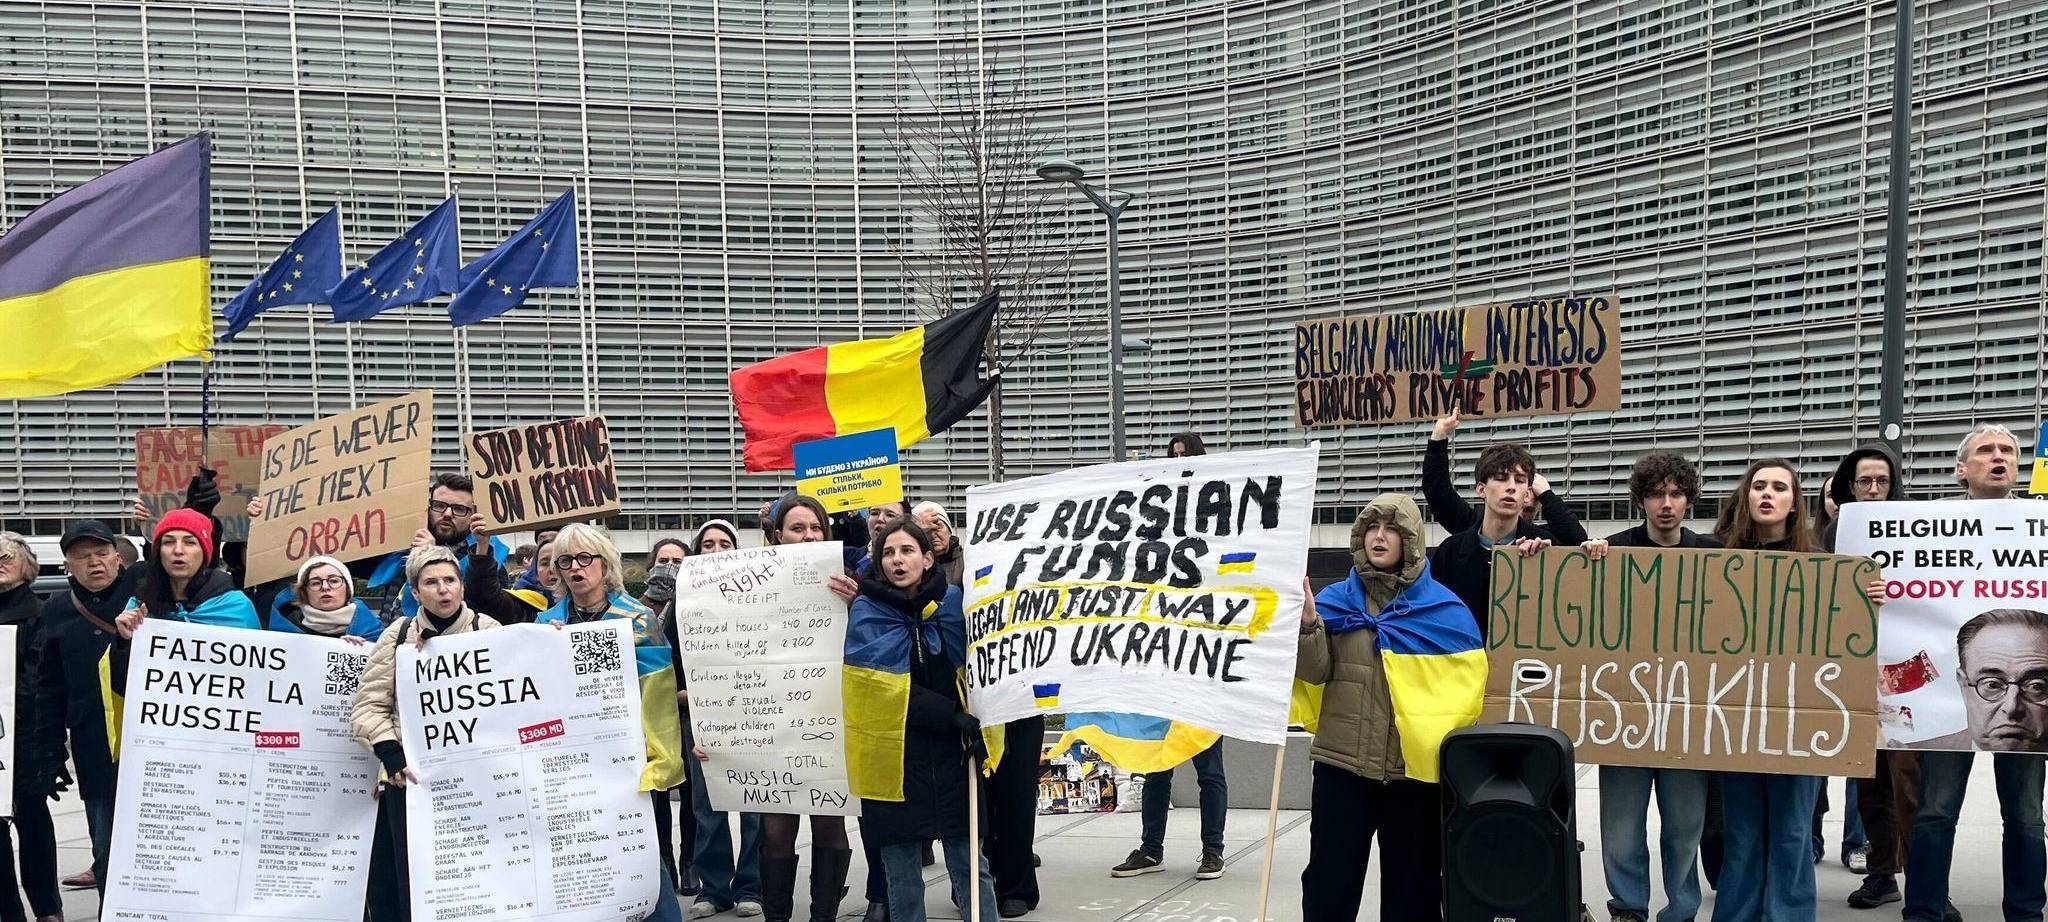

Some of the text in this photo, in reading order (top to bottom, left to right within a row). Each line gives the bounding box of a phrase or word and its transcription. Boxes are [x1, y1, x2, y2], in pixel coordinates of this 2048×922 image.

[1295, 297, 1609, 378] BELGIAN NATIONAL INTERESTS
[1409, 371, 1490, 418] PRIVATE
[1493, 367, 1595, 413] PROFITS
[136, 428, 202, 462] FACE
[264, 402, 419, 480] IS DE WEVER
[473, 418, 609, 479] STOP BETTING
[818, 464, 845, 475] БУДЕМО
[852, 456, 888, 469] УКРАЇНОЮ
[138, 458, 232, 492] CAUE
[833, 473, 864, 484] СТІЛЬКИ,
[489, 454, 617, 524] ON KREMLIN
[817, 479, 882, 496] СКІЛЬКИ ПОТРІБНО
[264, 478, 310, 521] THE
[970, 470, 1282, 546] USE RUSSIAN
[1869, 519, 1983, 539] BELGIUM
[1006, 537, 1209, 591] FUNDS
[1871, 549, 2048, 570] OF BEER, WAF
[728, 592, 781, 604] RECEIPT
[1885, 580, 1964, 598] OODY
[1012, 589, 1059, 624] AND
[1061, 586, 1147, 620] JUST
[1159, 592, 1248, 626] WAY
[1488, 549, 1663, 653] BELGIUM
[684, 618, 831, 635] Destroyed houses 140 000
[149, 635, 286, 671] FAISONS
[685, 640, 720, 651] Children
[727, 638, 750, 648] killed
[734, 650, 766, 660] injured
[976, 626, 1056, 688] DEFEND
[1070, 622, 1253, 683] UKRAINE
[416, 649, 492, 684] MAKE
[691, 669, 728, 682] Civilians
[783, 670, 795, 679] 20
[802, 668, 826, 678] 000
[145, 668, 303, 705] PAYER LA
[734, 680, 766, 690] detained
[420, 676, 540, 717] RUSSIA
[693, 696, 722, 708] Victims
[727, 696, 737, 707] of
[786, 690, 812, 701] 500
[140, 701, 262, 733] RUSSIE
[697, 717, 837, 735] Kidnapped children 19 500
[256, 735, 299, 745] $300 MD
[424, 717, 478, 750] PAY
[520, 723, 563, 742] $300 MD
[700, 735, 774, 748] Lives destroyed
[269, 762, 307, 770] DESTRUCTION
[542, 754, 577, 763] CULTURELE
[543, 758, 589, 768] TOERISTISCHE
[784, 755, 833, 768] TOTAL:
[430, 779, 450, 787] SCHADE
[431, 784, 457, 792] WONINGEN
[432, 791, 473, 801] VERNIETIGING
[744, 788, 848, 808] MUST PAY
[155, 809, 211, 817] INFRASTRUCTURES
[433, 801, 482, 813] INFRASTRUCTUUR
[550, 831, 597, 841] VERNIETIGING
[578, 835, 609, 843] KACHOVKA
[553, 856, 607, 868] EXPLOSIEGEVAAR
